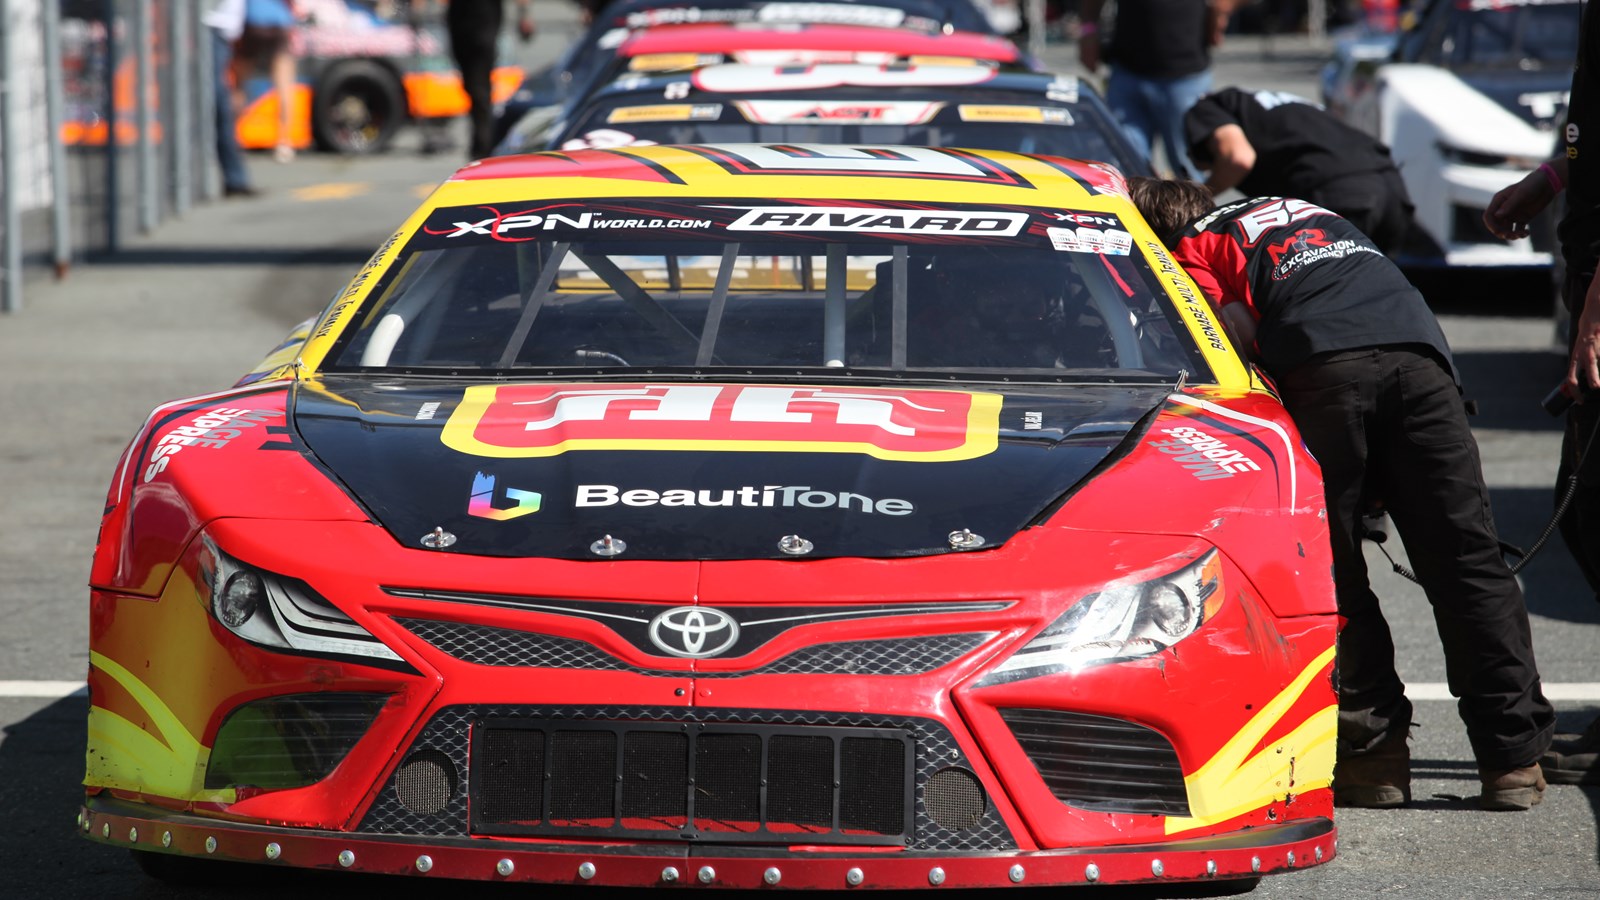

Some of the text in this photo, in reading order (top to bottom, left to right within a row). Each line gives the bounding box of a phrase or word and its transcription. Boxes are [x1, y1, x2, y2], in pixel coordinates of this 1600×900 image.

[750, 212, 1014, 232] RIVARD
[1280, 240, 1356, 275] EXCAVATION
[1303, 249, 1344, 266] MORENCY
[144, 407, 252, 483] EXPRESS
[1147, 438, 1235, 481] IMAGE
[1161, 426, 1262, 474] EXPRESS
[575, 485, 914, 516] BeautiTone
